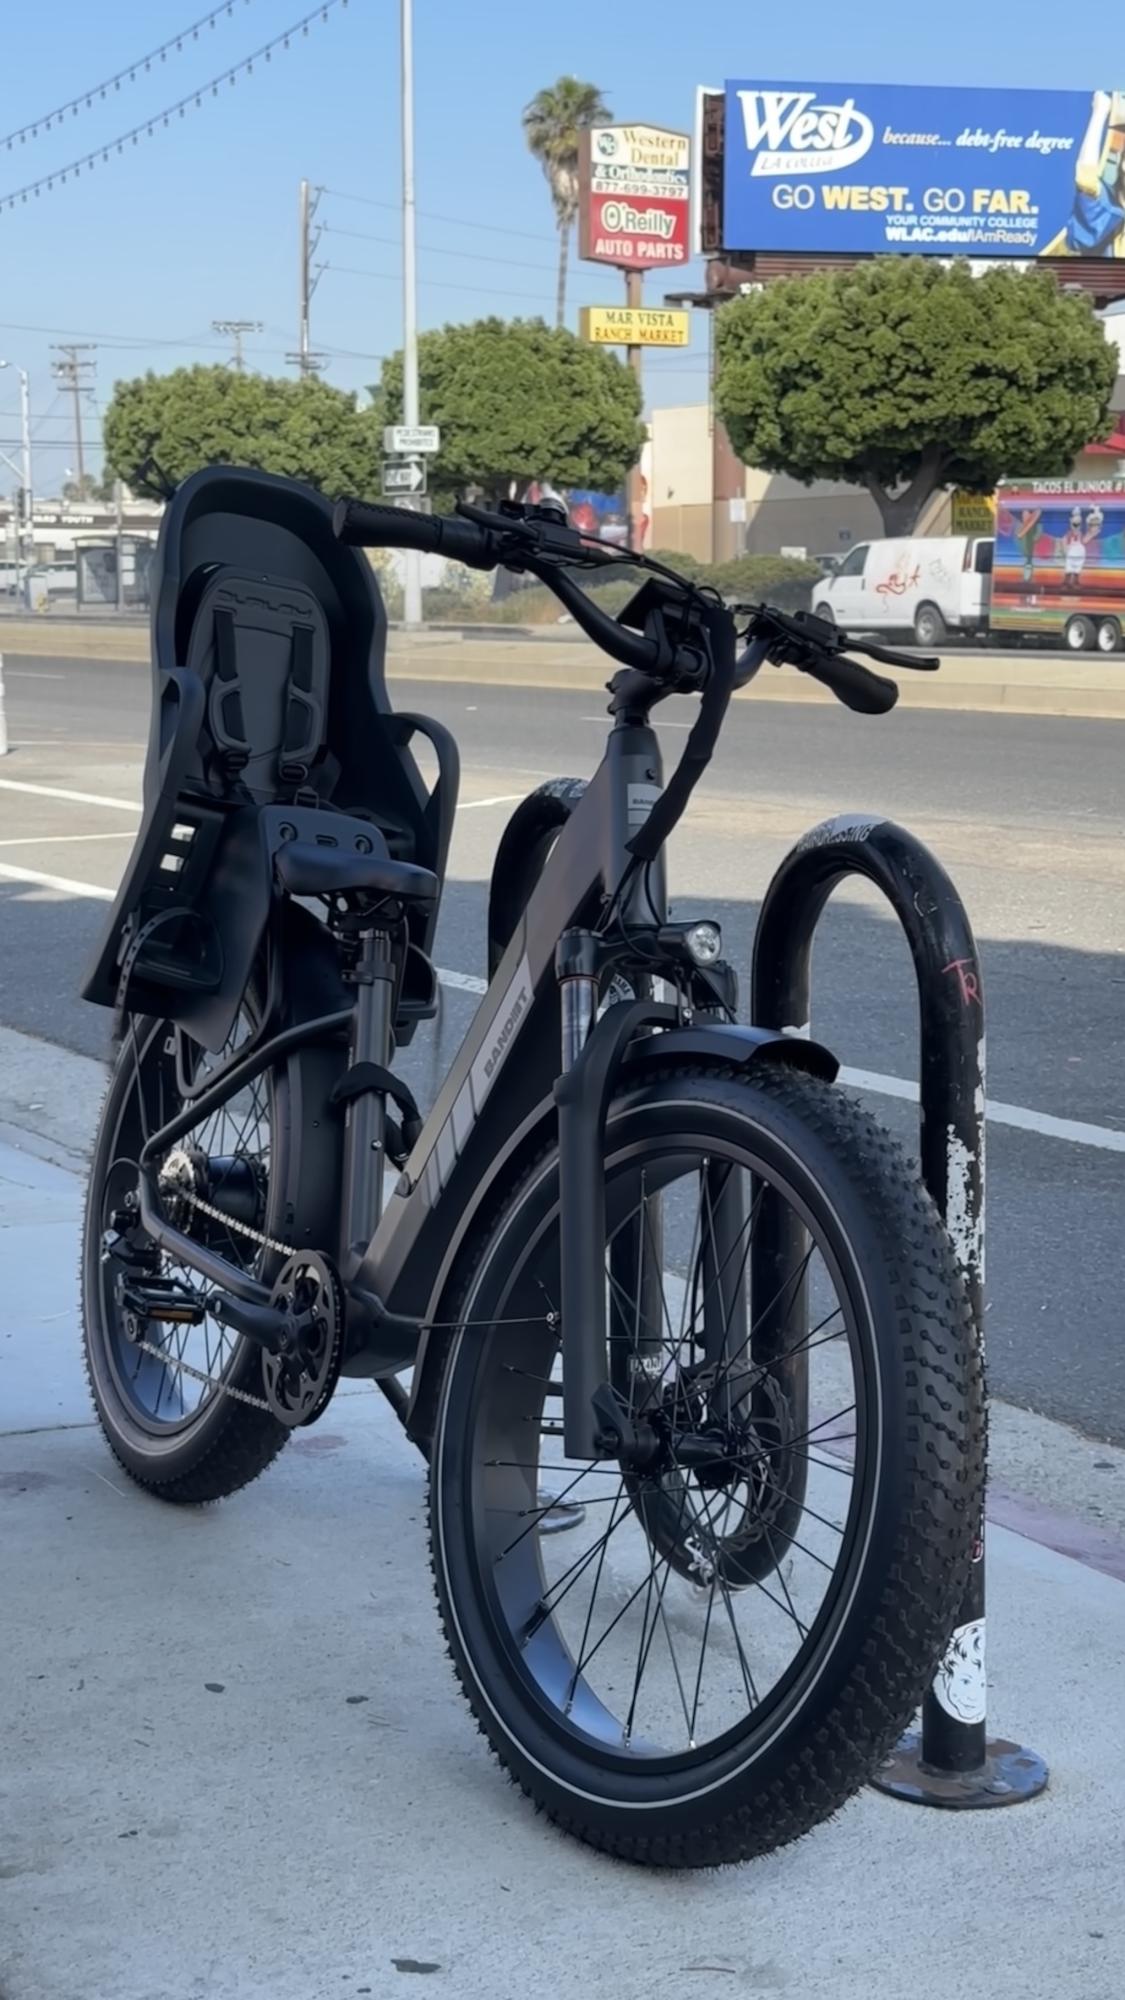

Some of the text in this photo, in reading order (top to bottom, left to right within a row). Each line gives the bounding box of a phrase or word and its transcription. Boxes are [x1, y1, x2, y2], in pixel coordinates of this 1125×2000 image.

[736, 90, 858, 150] West
[623, 130, 686, 150] Western
[883, 127, 1074, 154] because... debt-free degree
[632, 148, 678, 166] Dental
[760, 156, 782, 170] LA
[595, 180, 684, 197] 877-699-3797
[772, 184, 1039, 214] GO WEST. GO FAR.
[602, 201, 675, 236] O'Reilly
[886, 214, 1038, 229] YOUR COMMUNITY COLLEGE
[595, 238, 684, 260] AUTO PARTS
[605, 310, 674, 327] MAR VISTA
[595, 326, 684, 343] RANCH MARKET
[1032, 480, 1062, 494] TACOS
[1064, 480, 1075, 494] EL
[1076, 479, 1113, 494] JUNIOR
